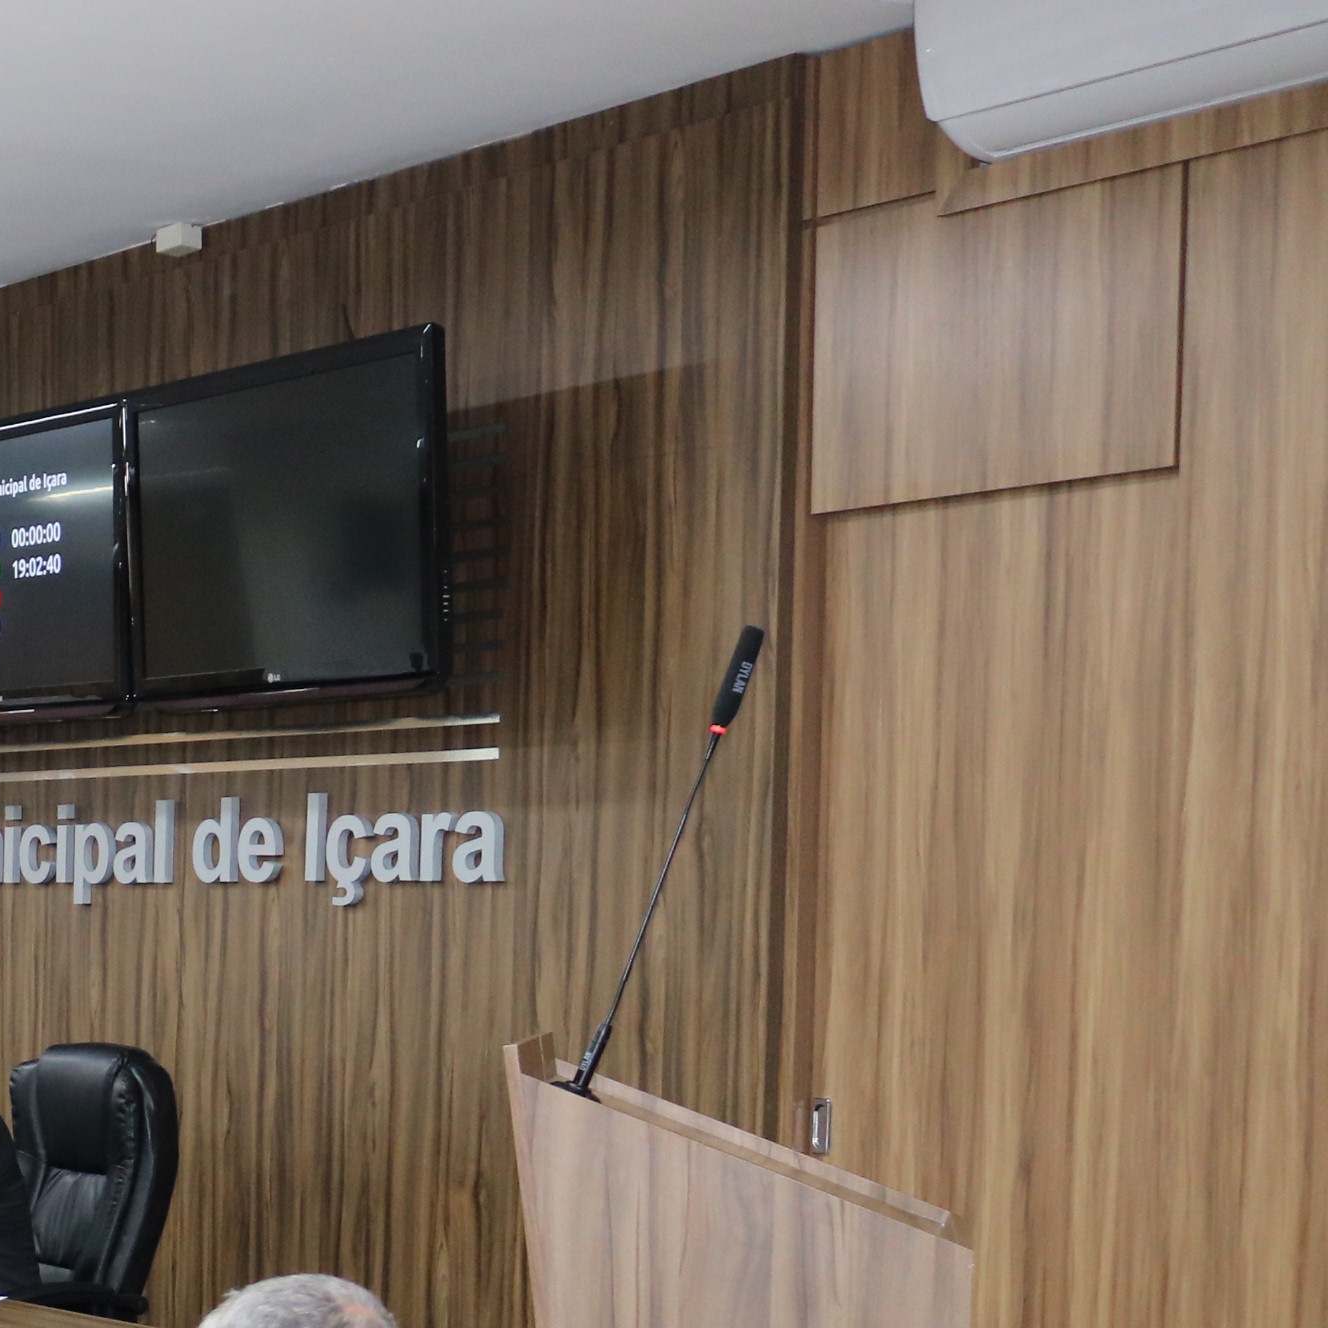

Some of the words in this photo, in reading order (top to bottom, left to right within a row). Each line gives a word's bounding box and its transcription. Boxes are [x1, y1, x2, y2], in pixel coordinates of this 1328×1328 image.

[29, 474, 41, 489] de
[43, 472, 67, 491] Içara
[11, 522, 61, 548] 00:00:00
[12, 553, 61, 579] 19:02:40
[732, 661, 753, 694] DYLAN
[192, 797, 284, 883] de
[305, 792, 505, 906] Içara
